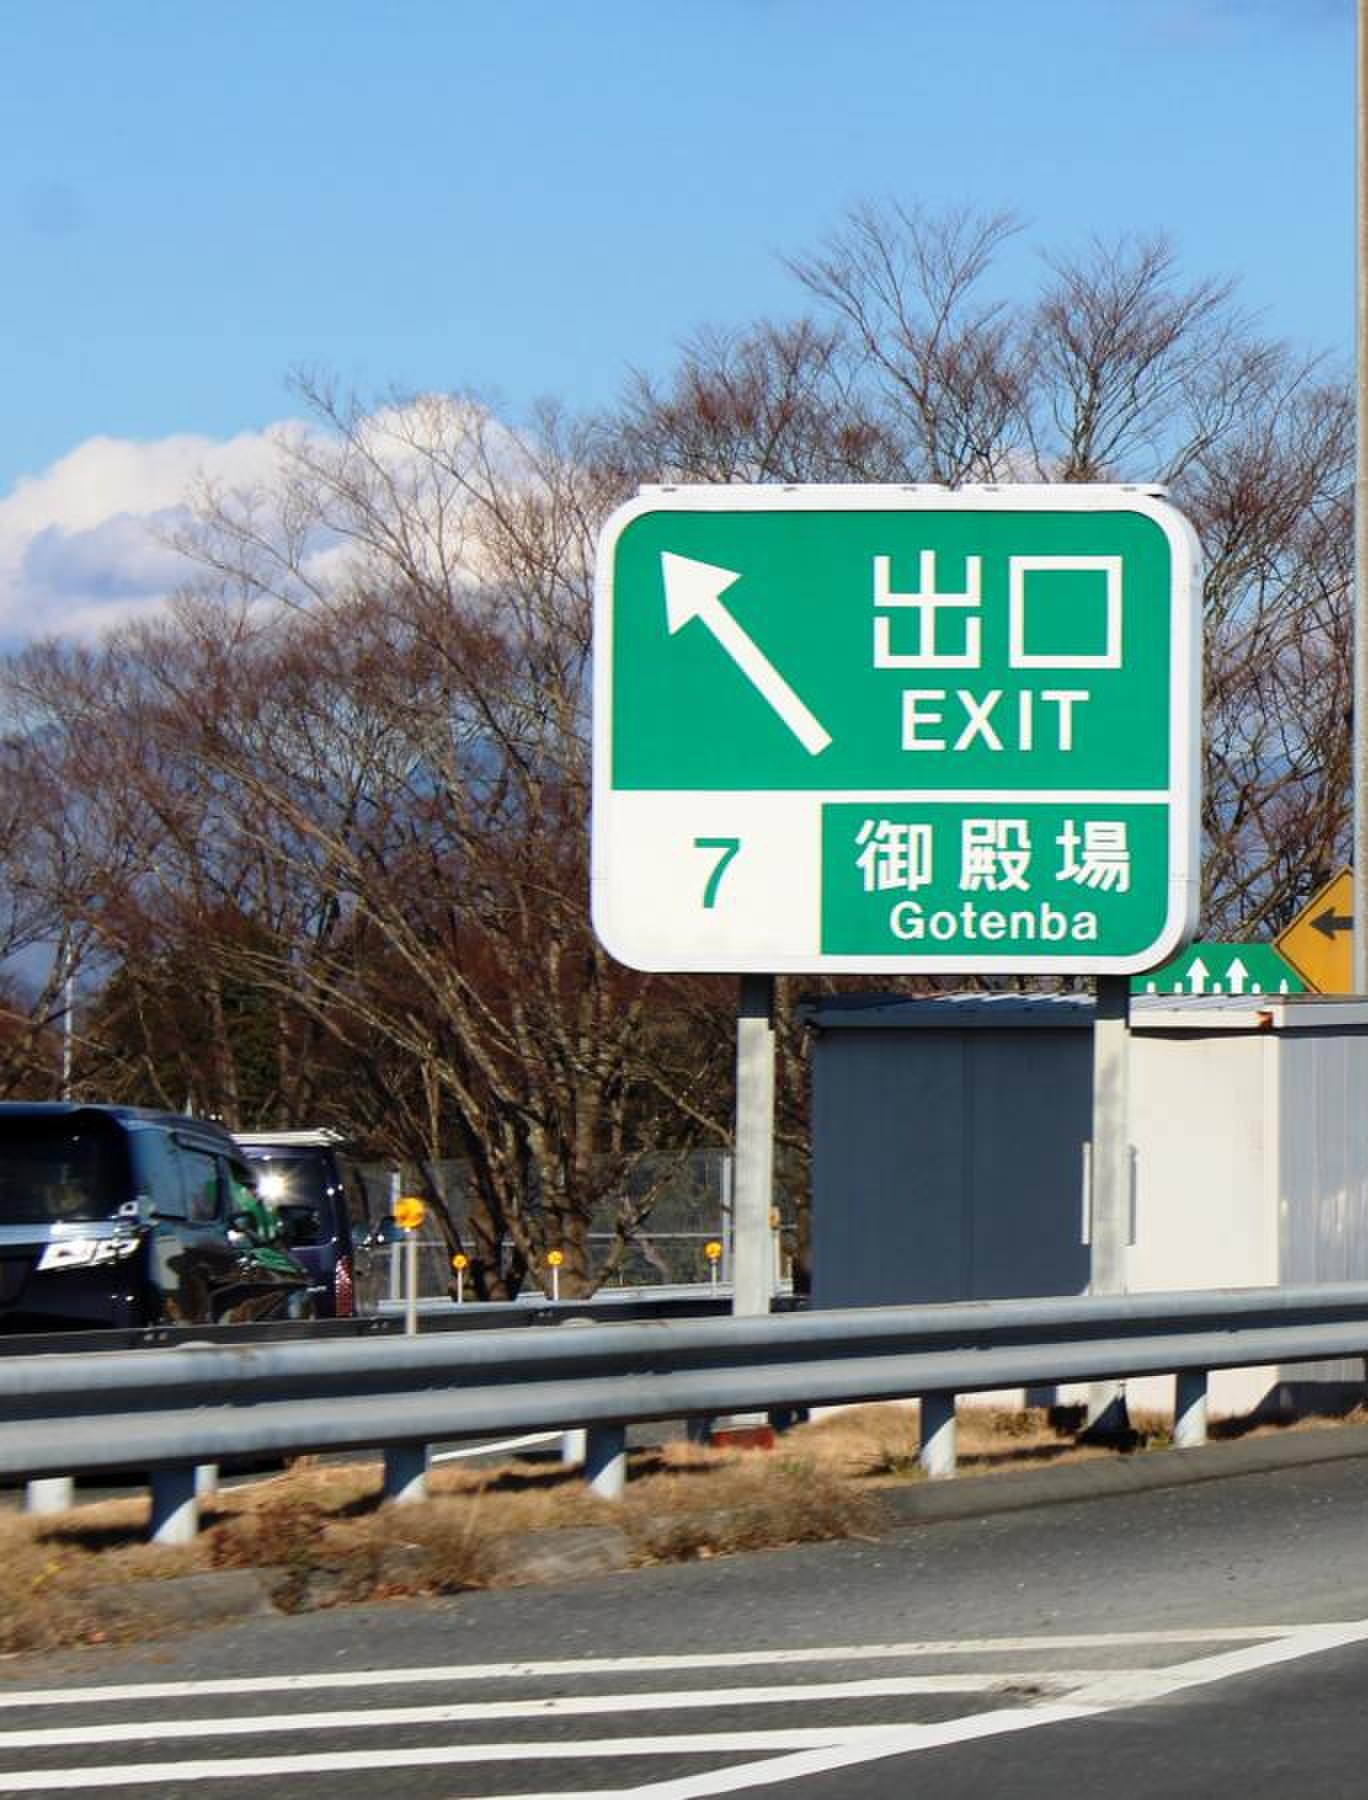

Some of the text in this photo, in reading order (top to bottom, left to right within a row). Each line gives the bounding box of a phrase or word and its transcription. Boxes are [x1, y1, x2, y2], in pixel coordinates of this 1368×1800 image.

[872, 549, 1123, 669] 出口
[900, 688, 1090, 751] EXIT
[693, 836, 742, 909] 7
[854, 818, 1131, 893] 御殿場
[888, 900, 1099, 941] Gotenba
